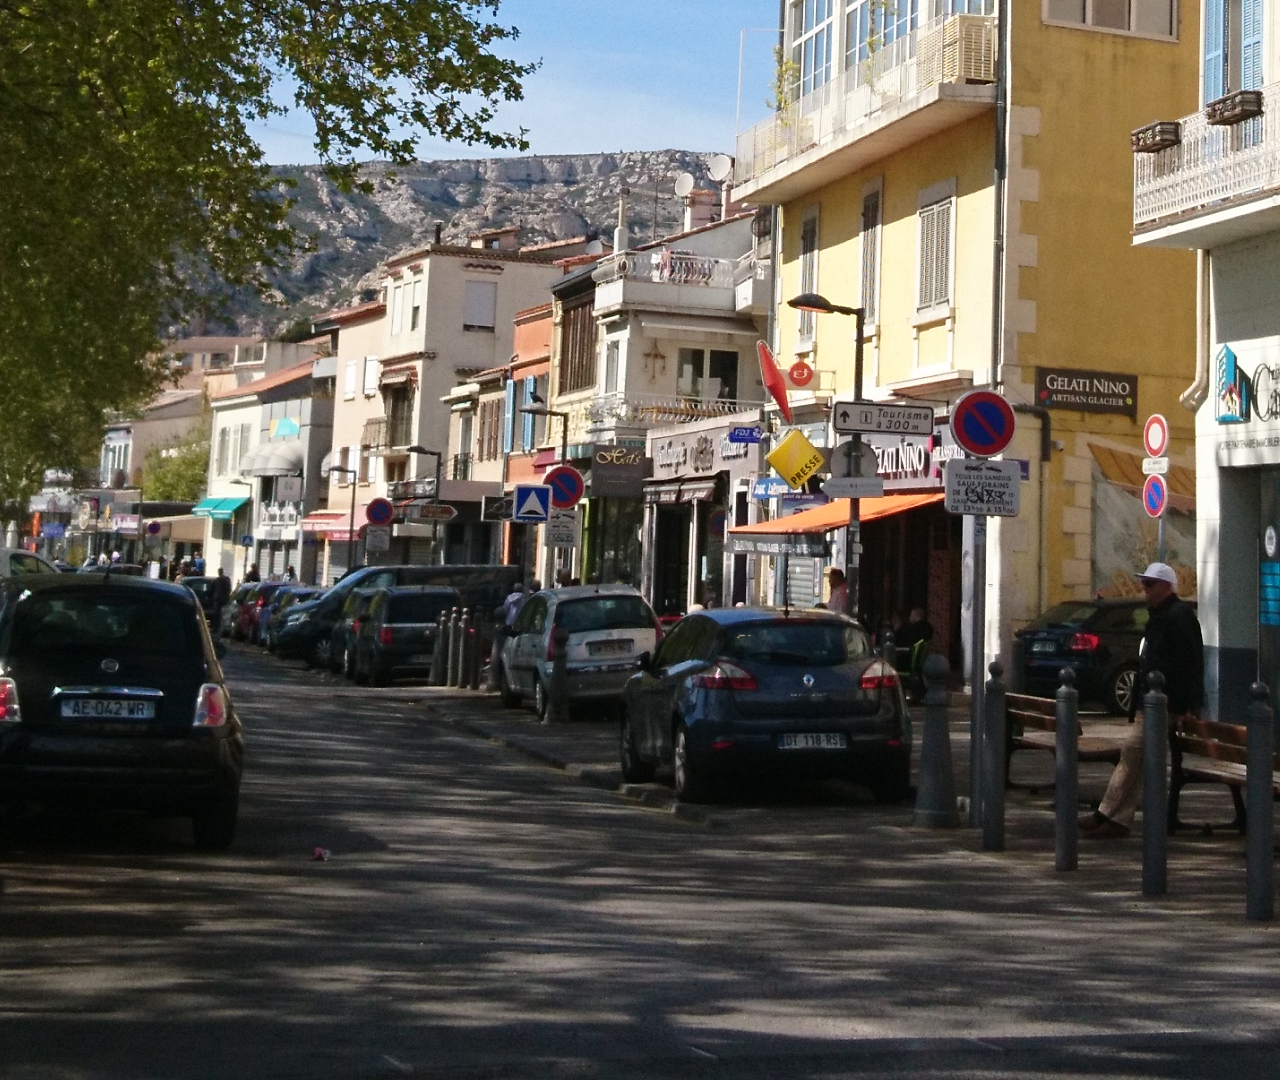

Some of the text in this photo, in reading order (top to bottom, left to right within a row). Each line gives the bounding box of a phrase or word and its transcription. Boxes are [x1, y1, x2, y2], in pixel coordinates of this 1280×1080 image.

[1045, 374, 1130, 395] GELATI NINO
[1051, 394, 1124, 407] ARTISAN GLACIER
[877, 408, 929, 420] Tourisme
[886, 420, 910, 430] 300
[734, 428, 750, 436] FDJ
[898, 441, 925, 472] NINO
[790, 454, 820, 485] PRESSE
[977, 481, 1010, 489] FORAINS
